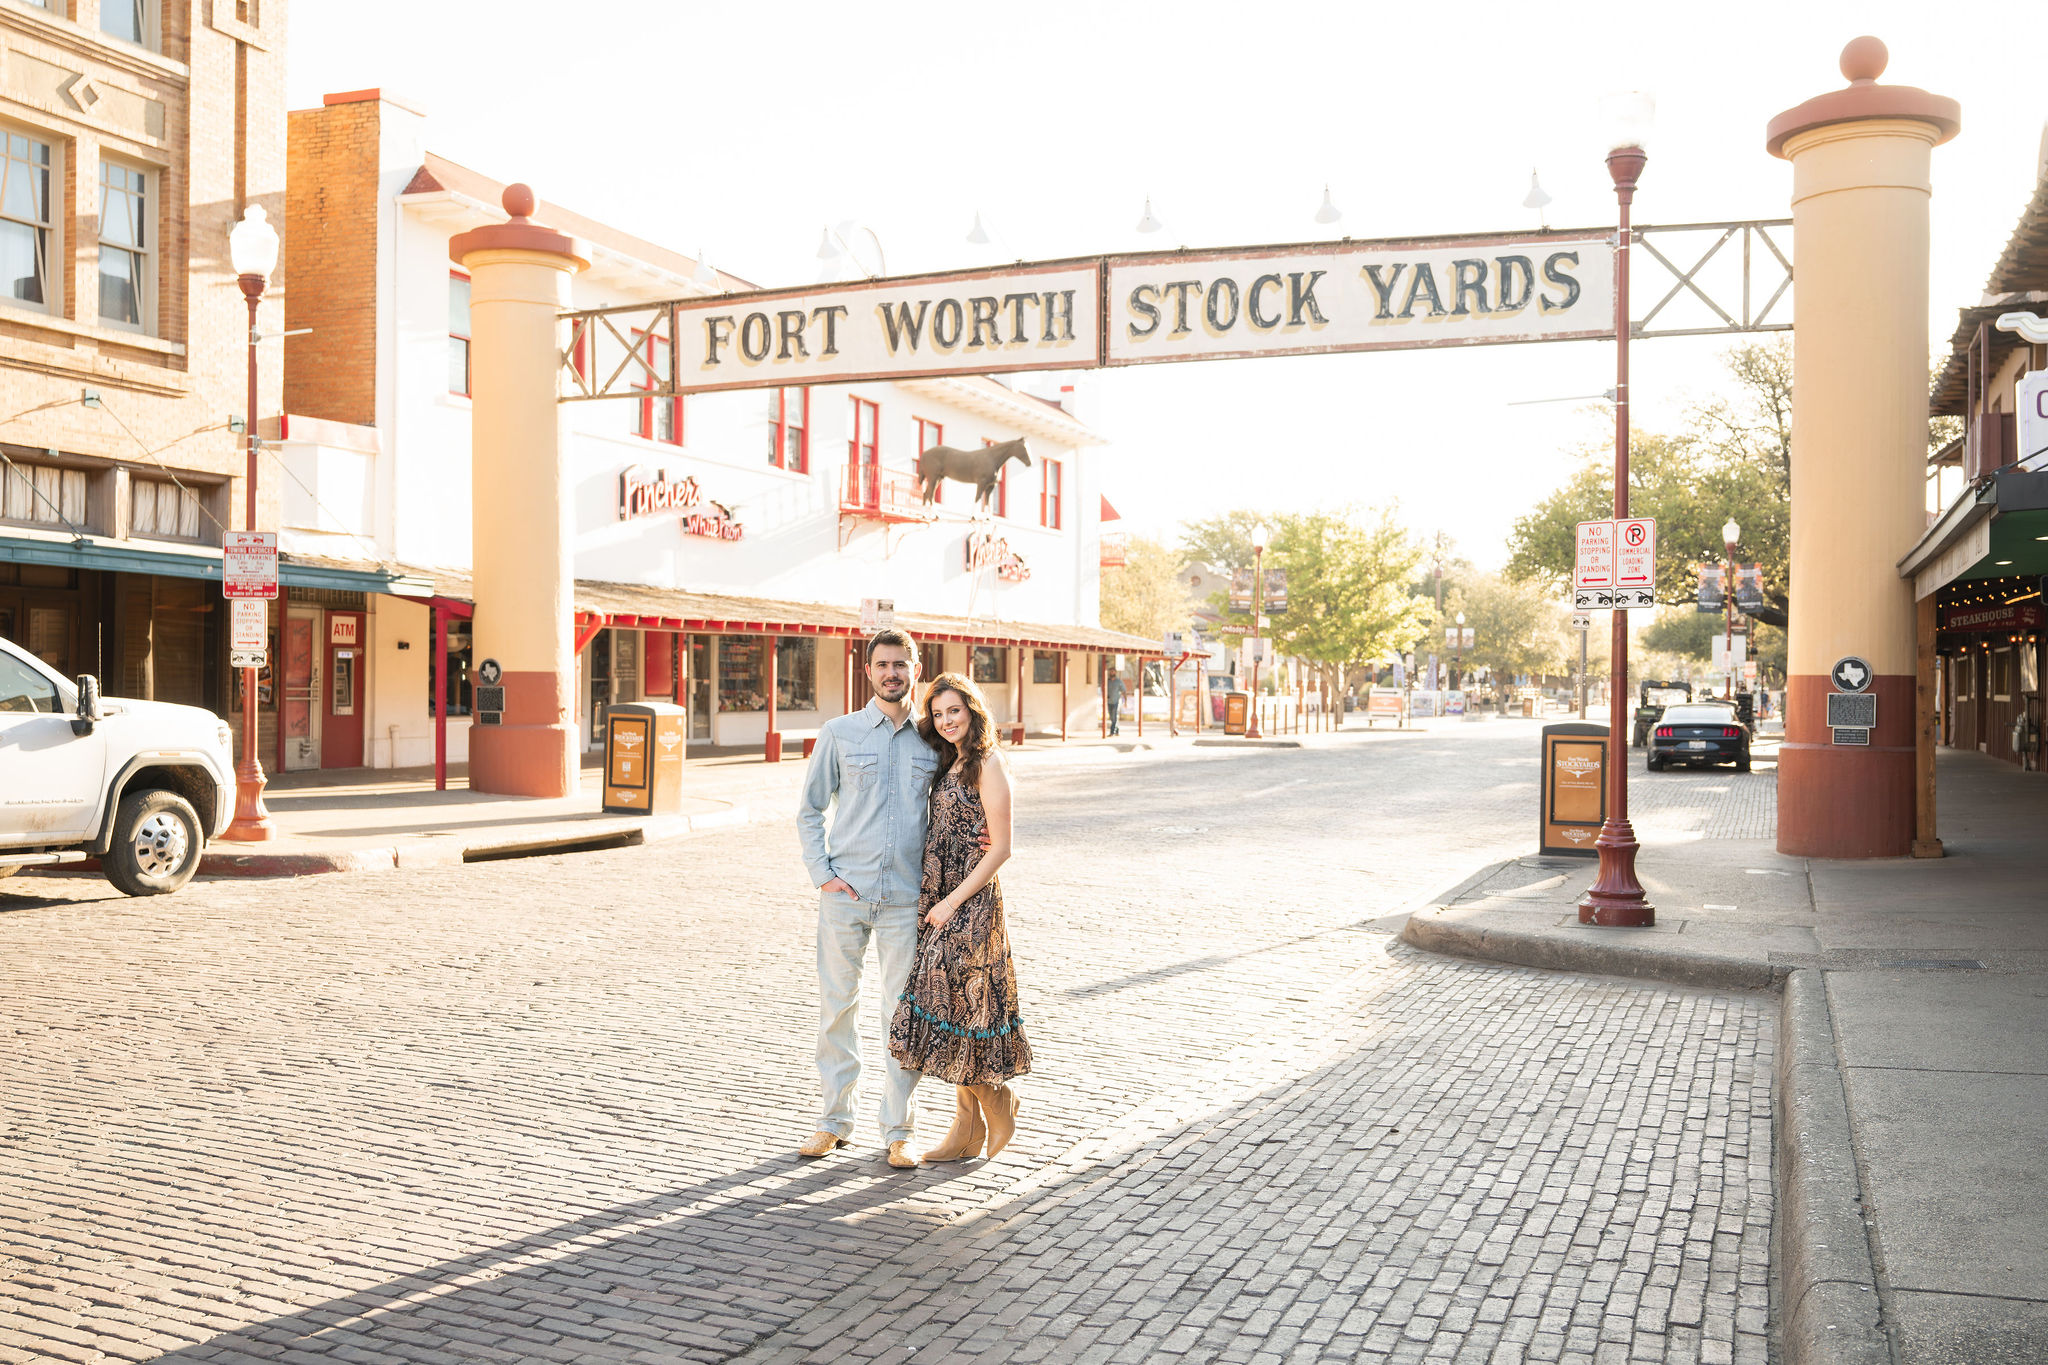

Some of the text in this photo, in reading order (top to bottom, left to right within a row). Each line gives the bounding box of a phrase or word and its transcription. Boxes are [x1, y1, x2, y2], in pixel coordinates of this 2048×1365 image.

[1127, 251, 1582, 342] STOCK YARDS
[702, 289, 1077, 369] FORT WORTH
[1588, 527, 1602, 536] NO
[1581, 537, 1609, 546] PARKING
[1580, 547, 1611, 556] STOPPING
[1618, 547, 1651, 556] COMMERCIAL
[1590, 556, 1600, 564] OR
[1622, 557, 1644, 566] LOADING
[1580, 565, 1611, 574] STANDING
[1627, 566, 1642, 574] ZONE
[1950, 607, 2015, 628] STEAKHOUSE
[333, 623, 355, 637] ATM
[1556, 760, 1601, 769] STOCKYARDS
